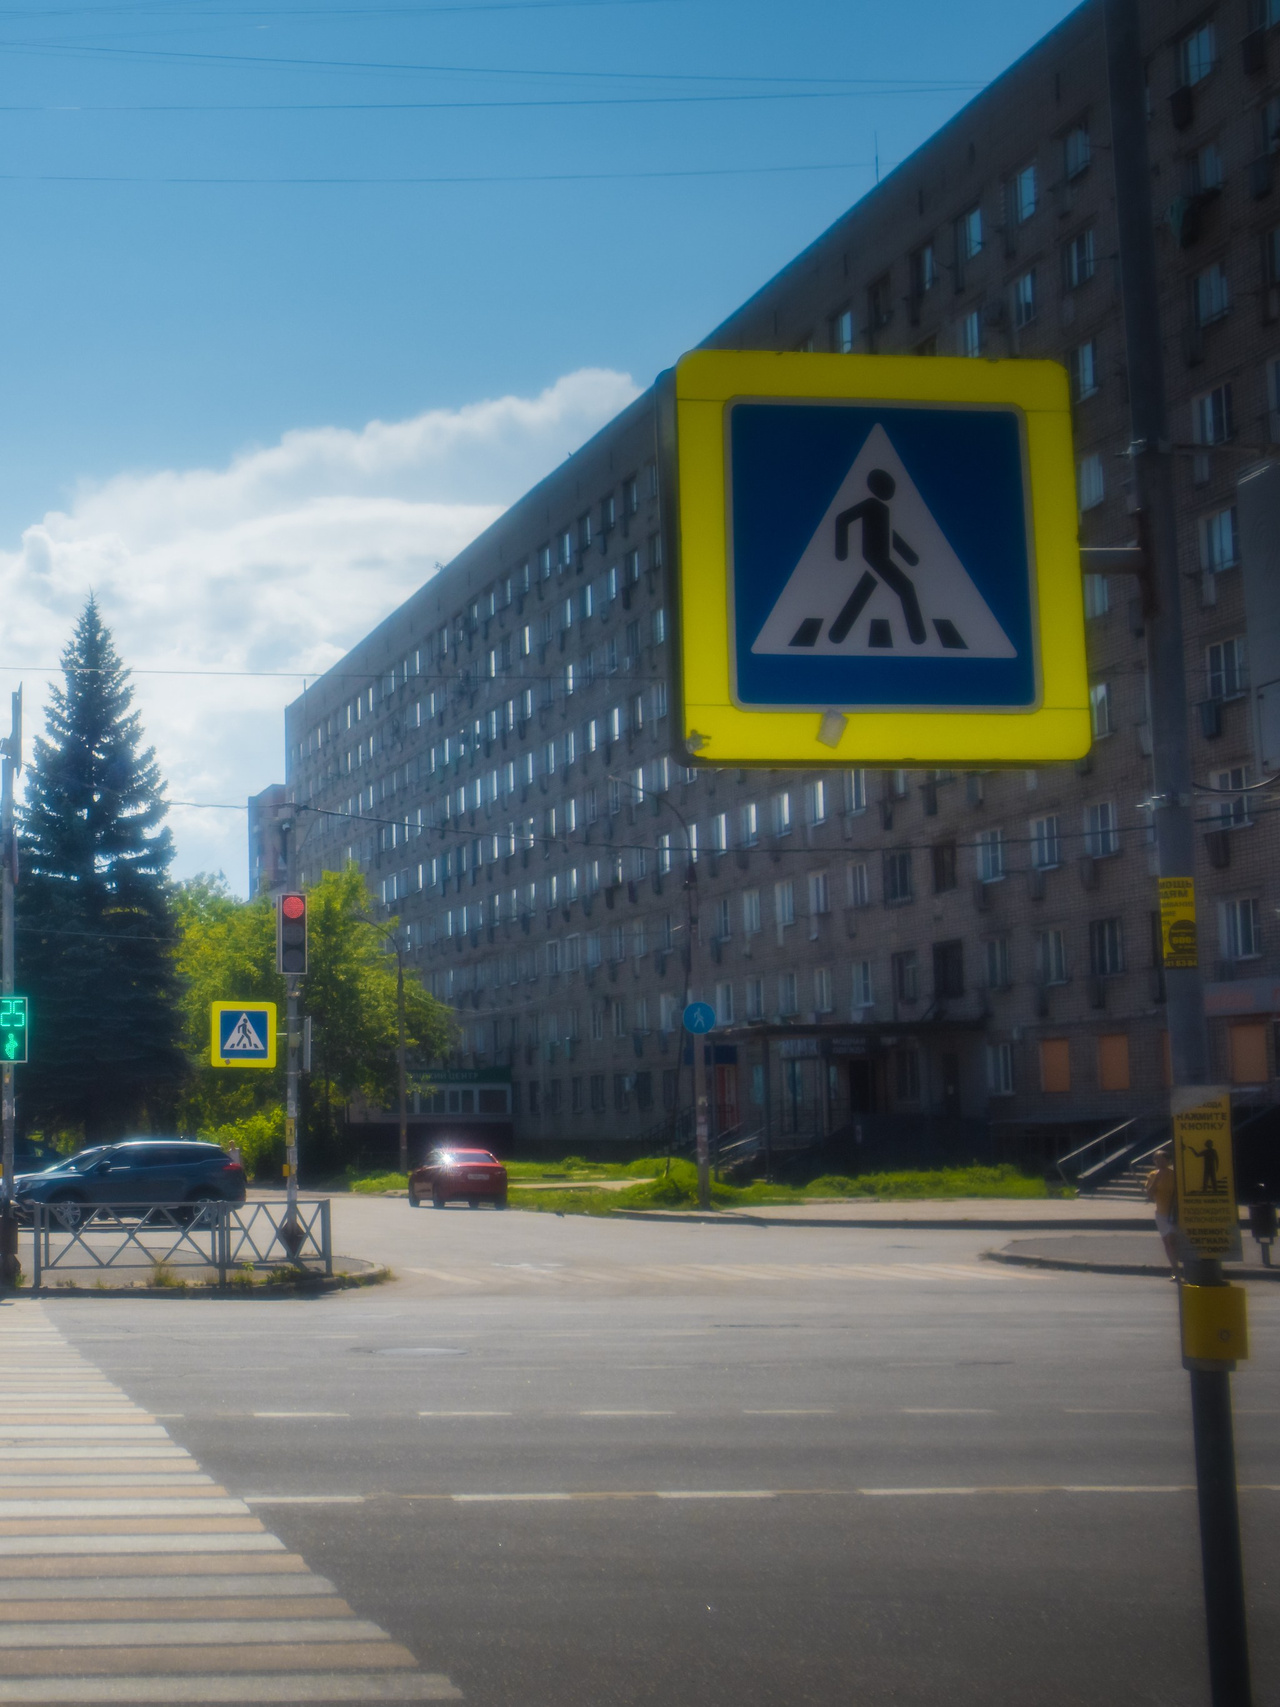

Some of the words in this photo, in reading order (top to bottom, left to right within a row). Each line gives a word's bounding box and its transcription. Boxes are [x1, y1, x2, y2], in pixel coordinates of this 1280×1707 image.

[0, 1000, 25, 1027] 25
[1176, 1112, 1228, 1121] НАЖМИТЕ
[1180, 1122, 1225, 1131] КНОПКУ
[1183, 1216, 1232, 1224] ВКЛЮЧЕНИЯ
[1189, 1237, 1230, 1245] СИГНАЛА
